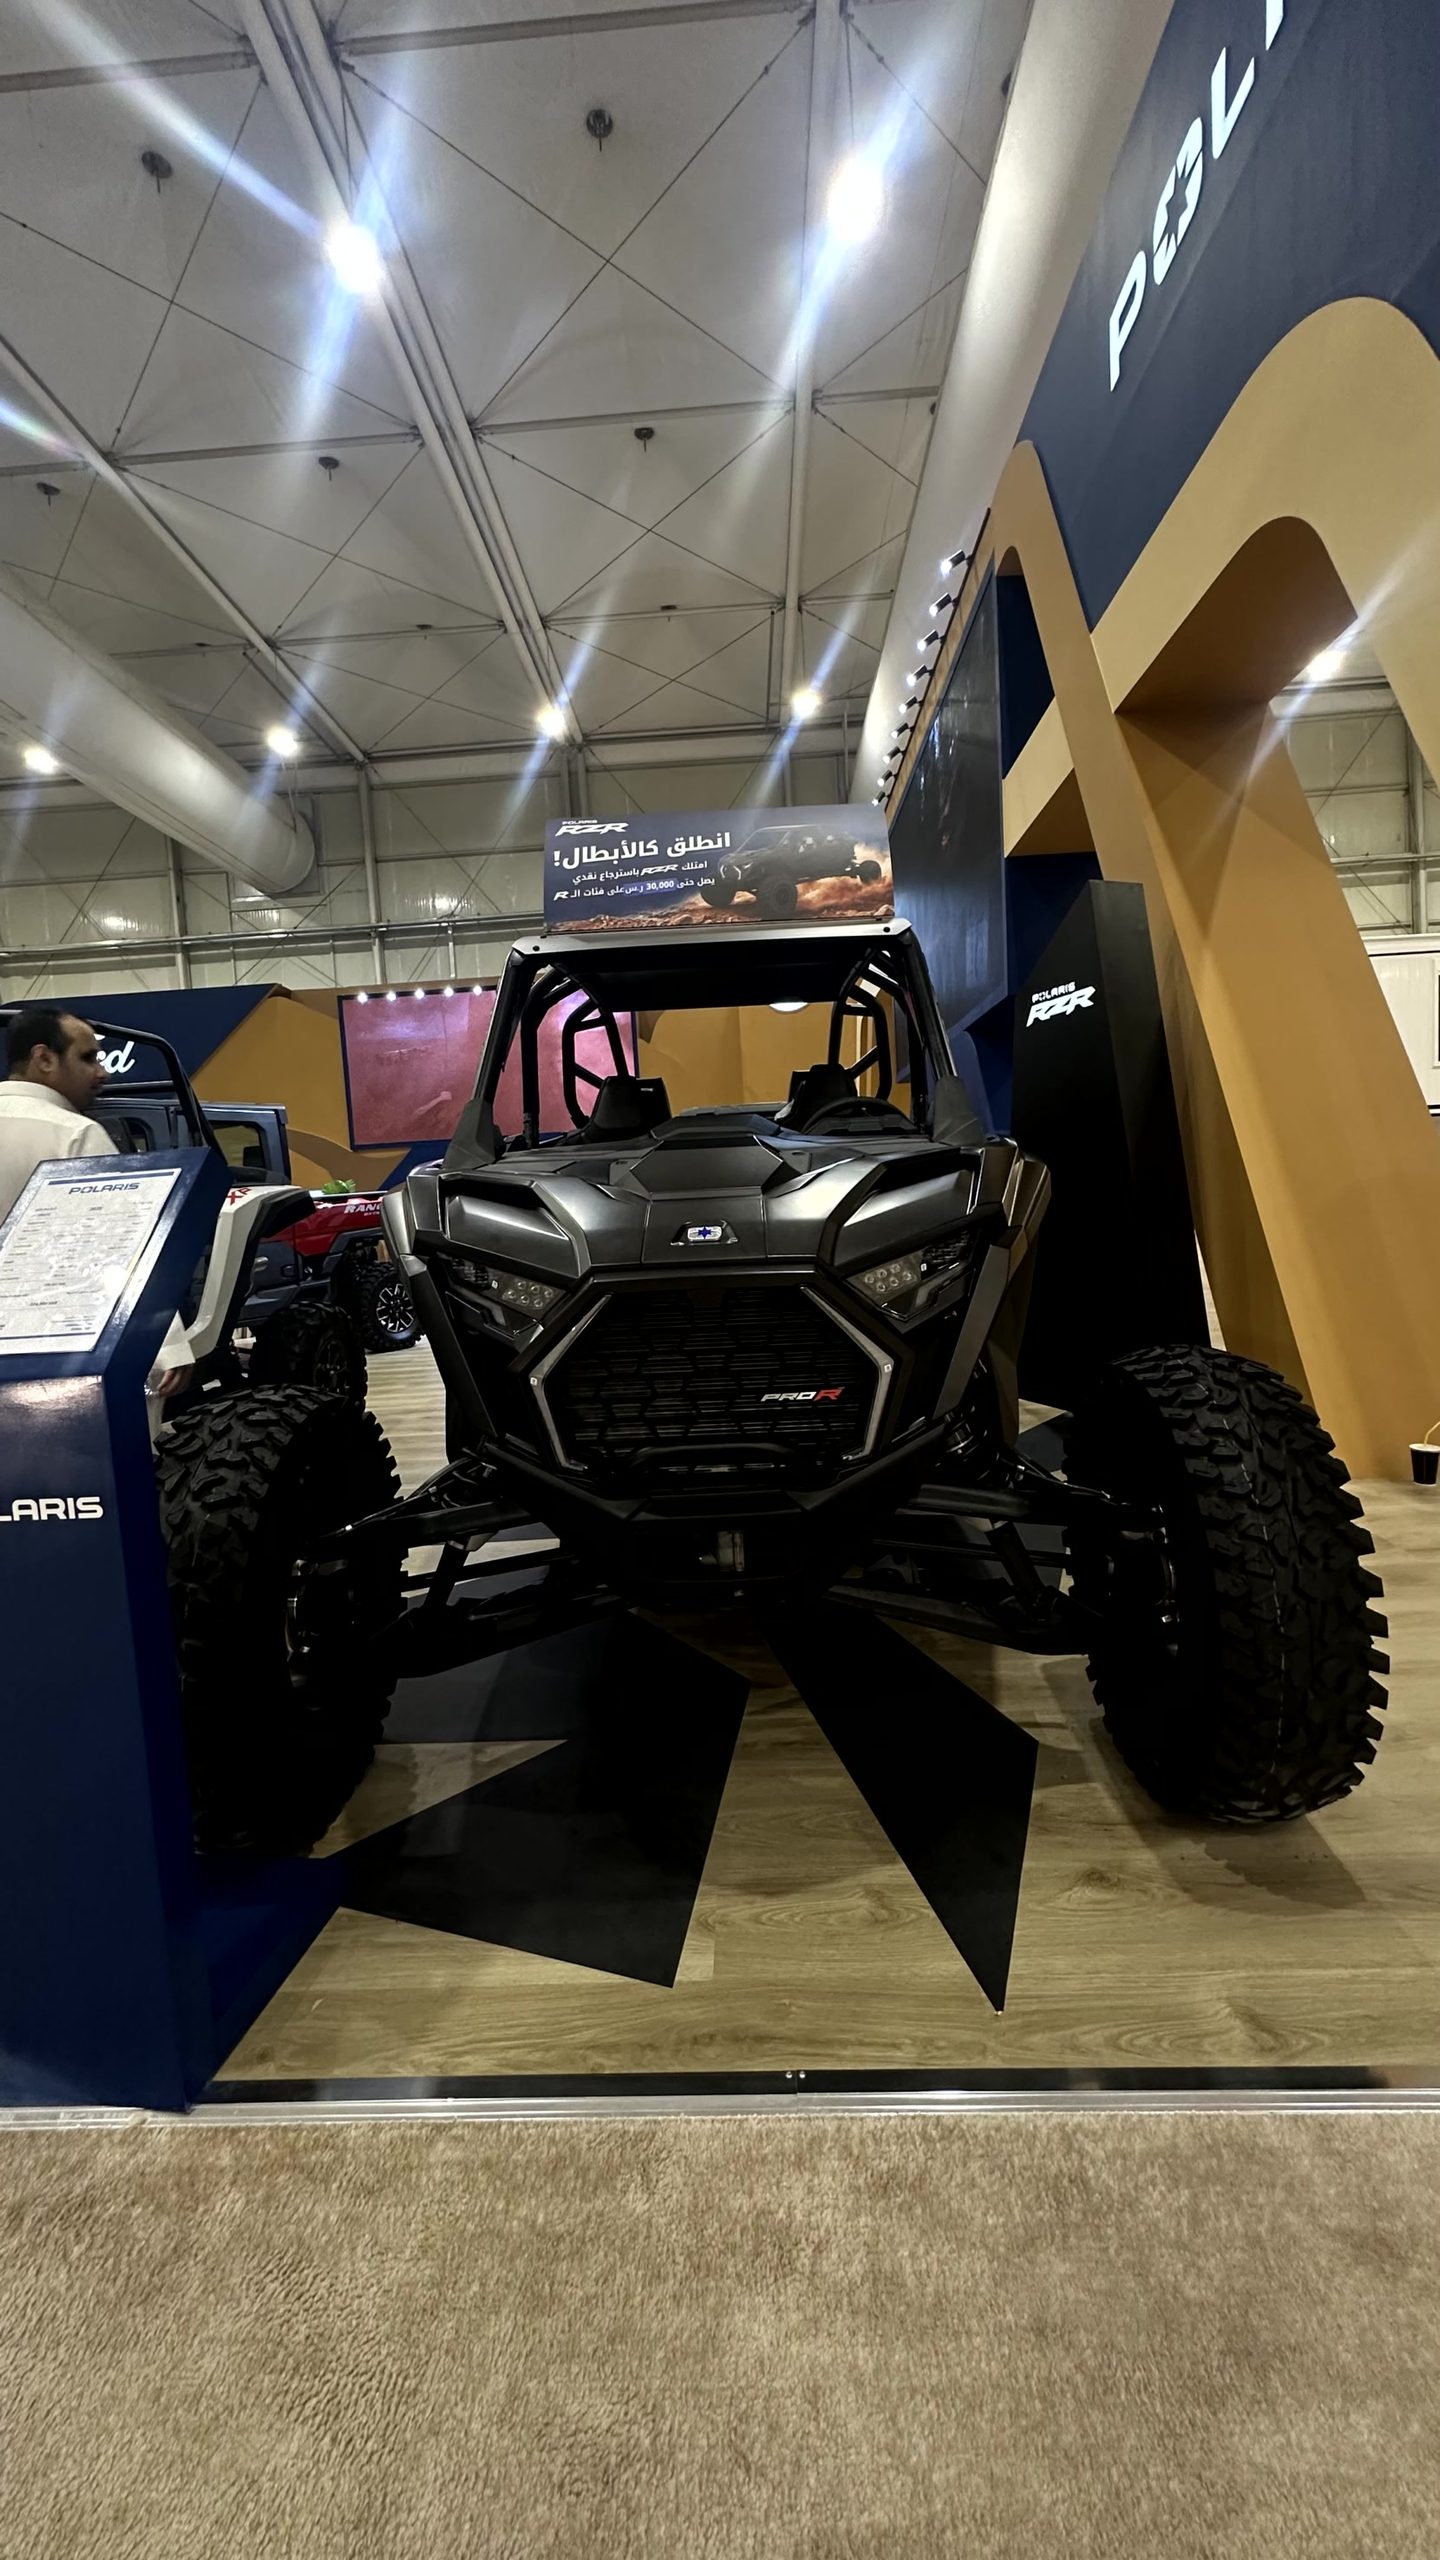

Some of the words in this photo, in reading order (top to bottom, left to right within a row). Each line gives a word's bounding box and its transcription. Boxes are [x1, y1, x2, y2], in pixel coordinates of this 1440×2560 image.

[1109, 0, 1284, 391] POL
[555, 823, 629, 837] RZR
[667, 832, 731, 858] انطلق
[553, 839, 659, 870] كالأبطال!
[640, 864, 680, 876] RZR
[681, 860, 708, 872] امتلك
[572, 872, 597, 886] نقدي
[599, 867, 640, 882] باسترجاع
[646, 880, 675, 892] 30,000
[676, 878, 694, 890] حتى
[697, 877, 716, 888] يصل
[553, 890, 570, 901] R
[583, 886, 605, 898] فئات
[1031, 981, 1076, 1003] POLARIS
[1026, 986, 1096, 1027] RZR
[68, 1182, 140, 1195] POLARIS
[344, 1203, 380, 1214] RAN
